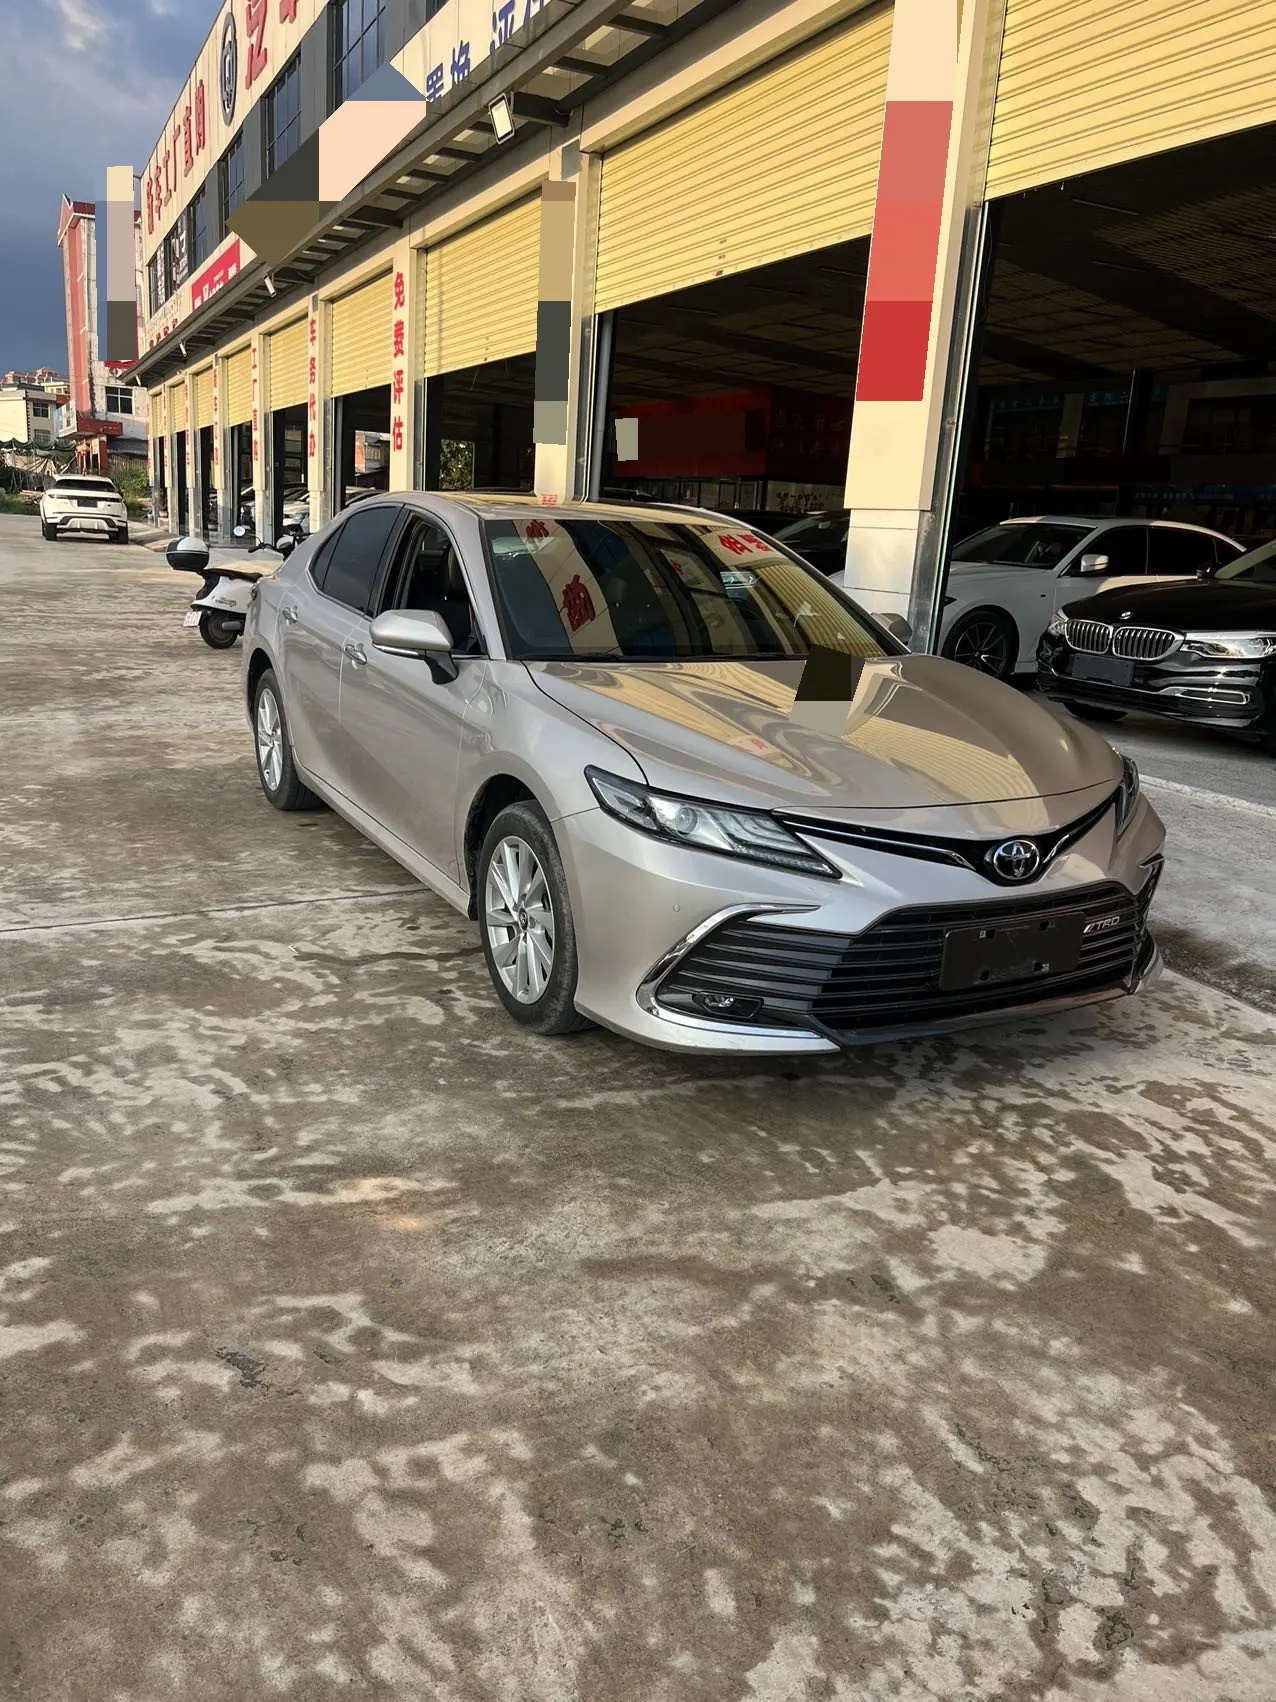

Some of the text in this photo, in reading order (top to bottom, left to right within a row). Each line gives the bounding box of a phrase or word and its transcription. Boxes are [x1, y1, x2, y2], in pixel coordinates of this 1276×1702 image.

[392, 271, 405, 452] 免费评估
[1096, 916, 1120, 930] TRD
